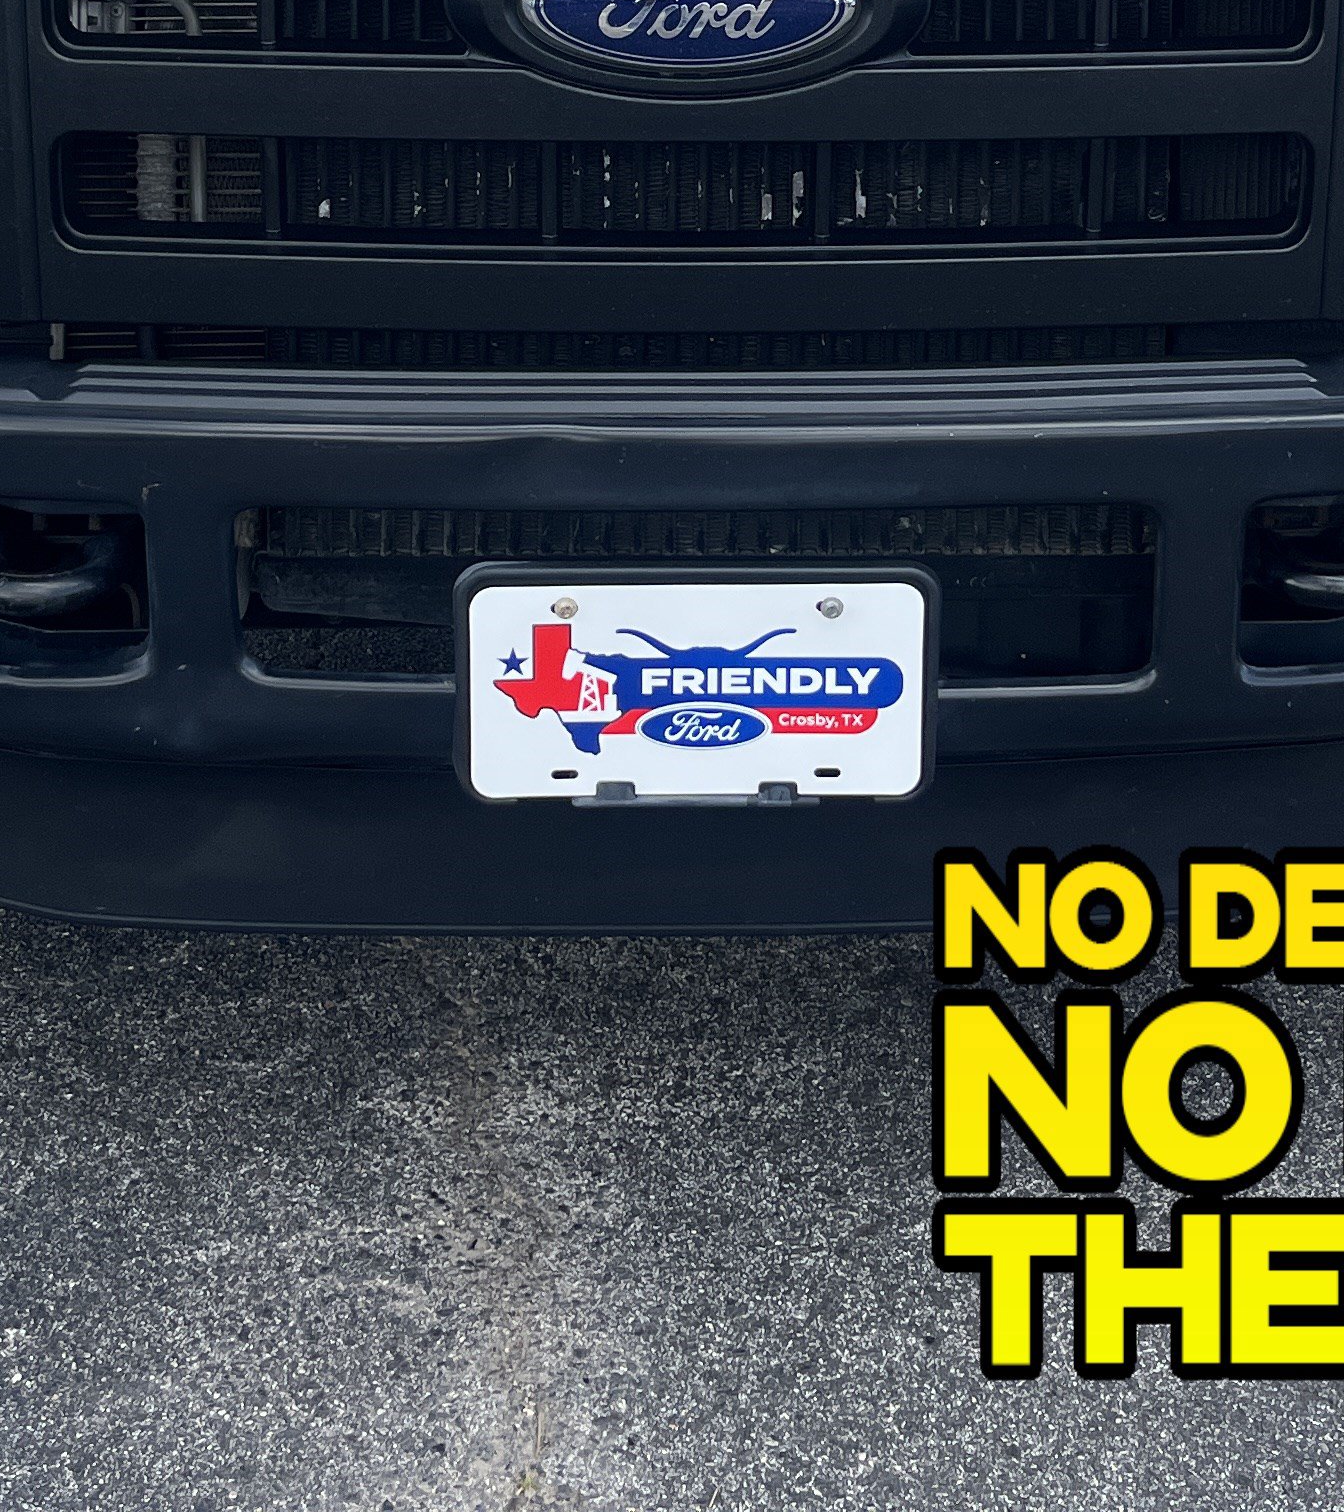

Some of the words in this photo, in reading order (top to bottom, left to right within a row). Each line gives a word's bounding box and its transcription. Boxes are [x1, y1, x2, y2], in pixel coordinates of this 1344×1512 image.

[641, 667, 881, 696] FRIENDLY
[663, 709, 741, 742] Ford
[777, 712, 839, 728] Crosby,
[840, 713, 864, 727] TX
